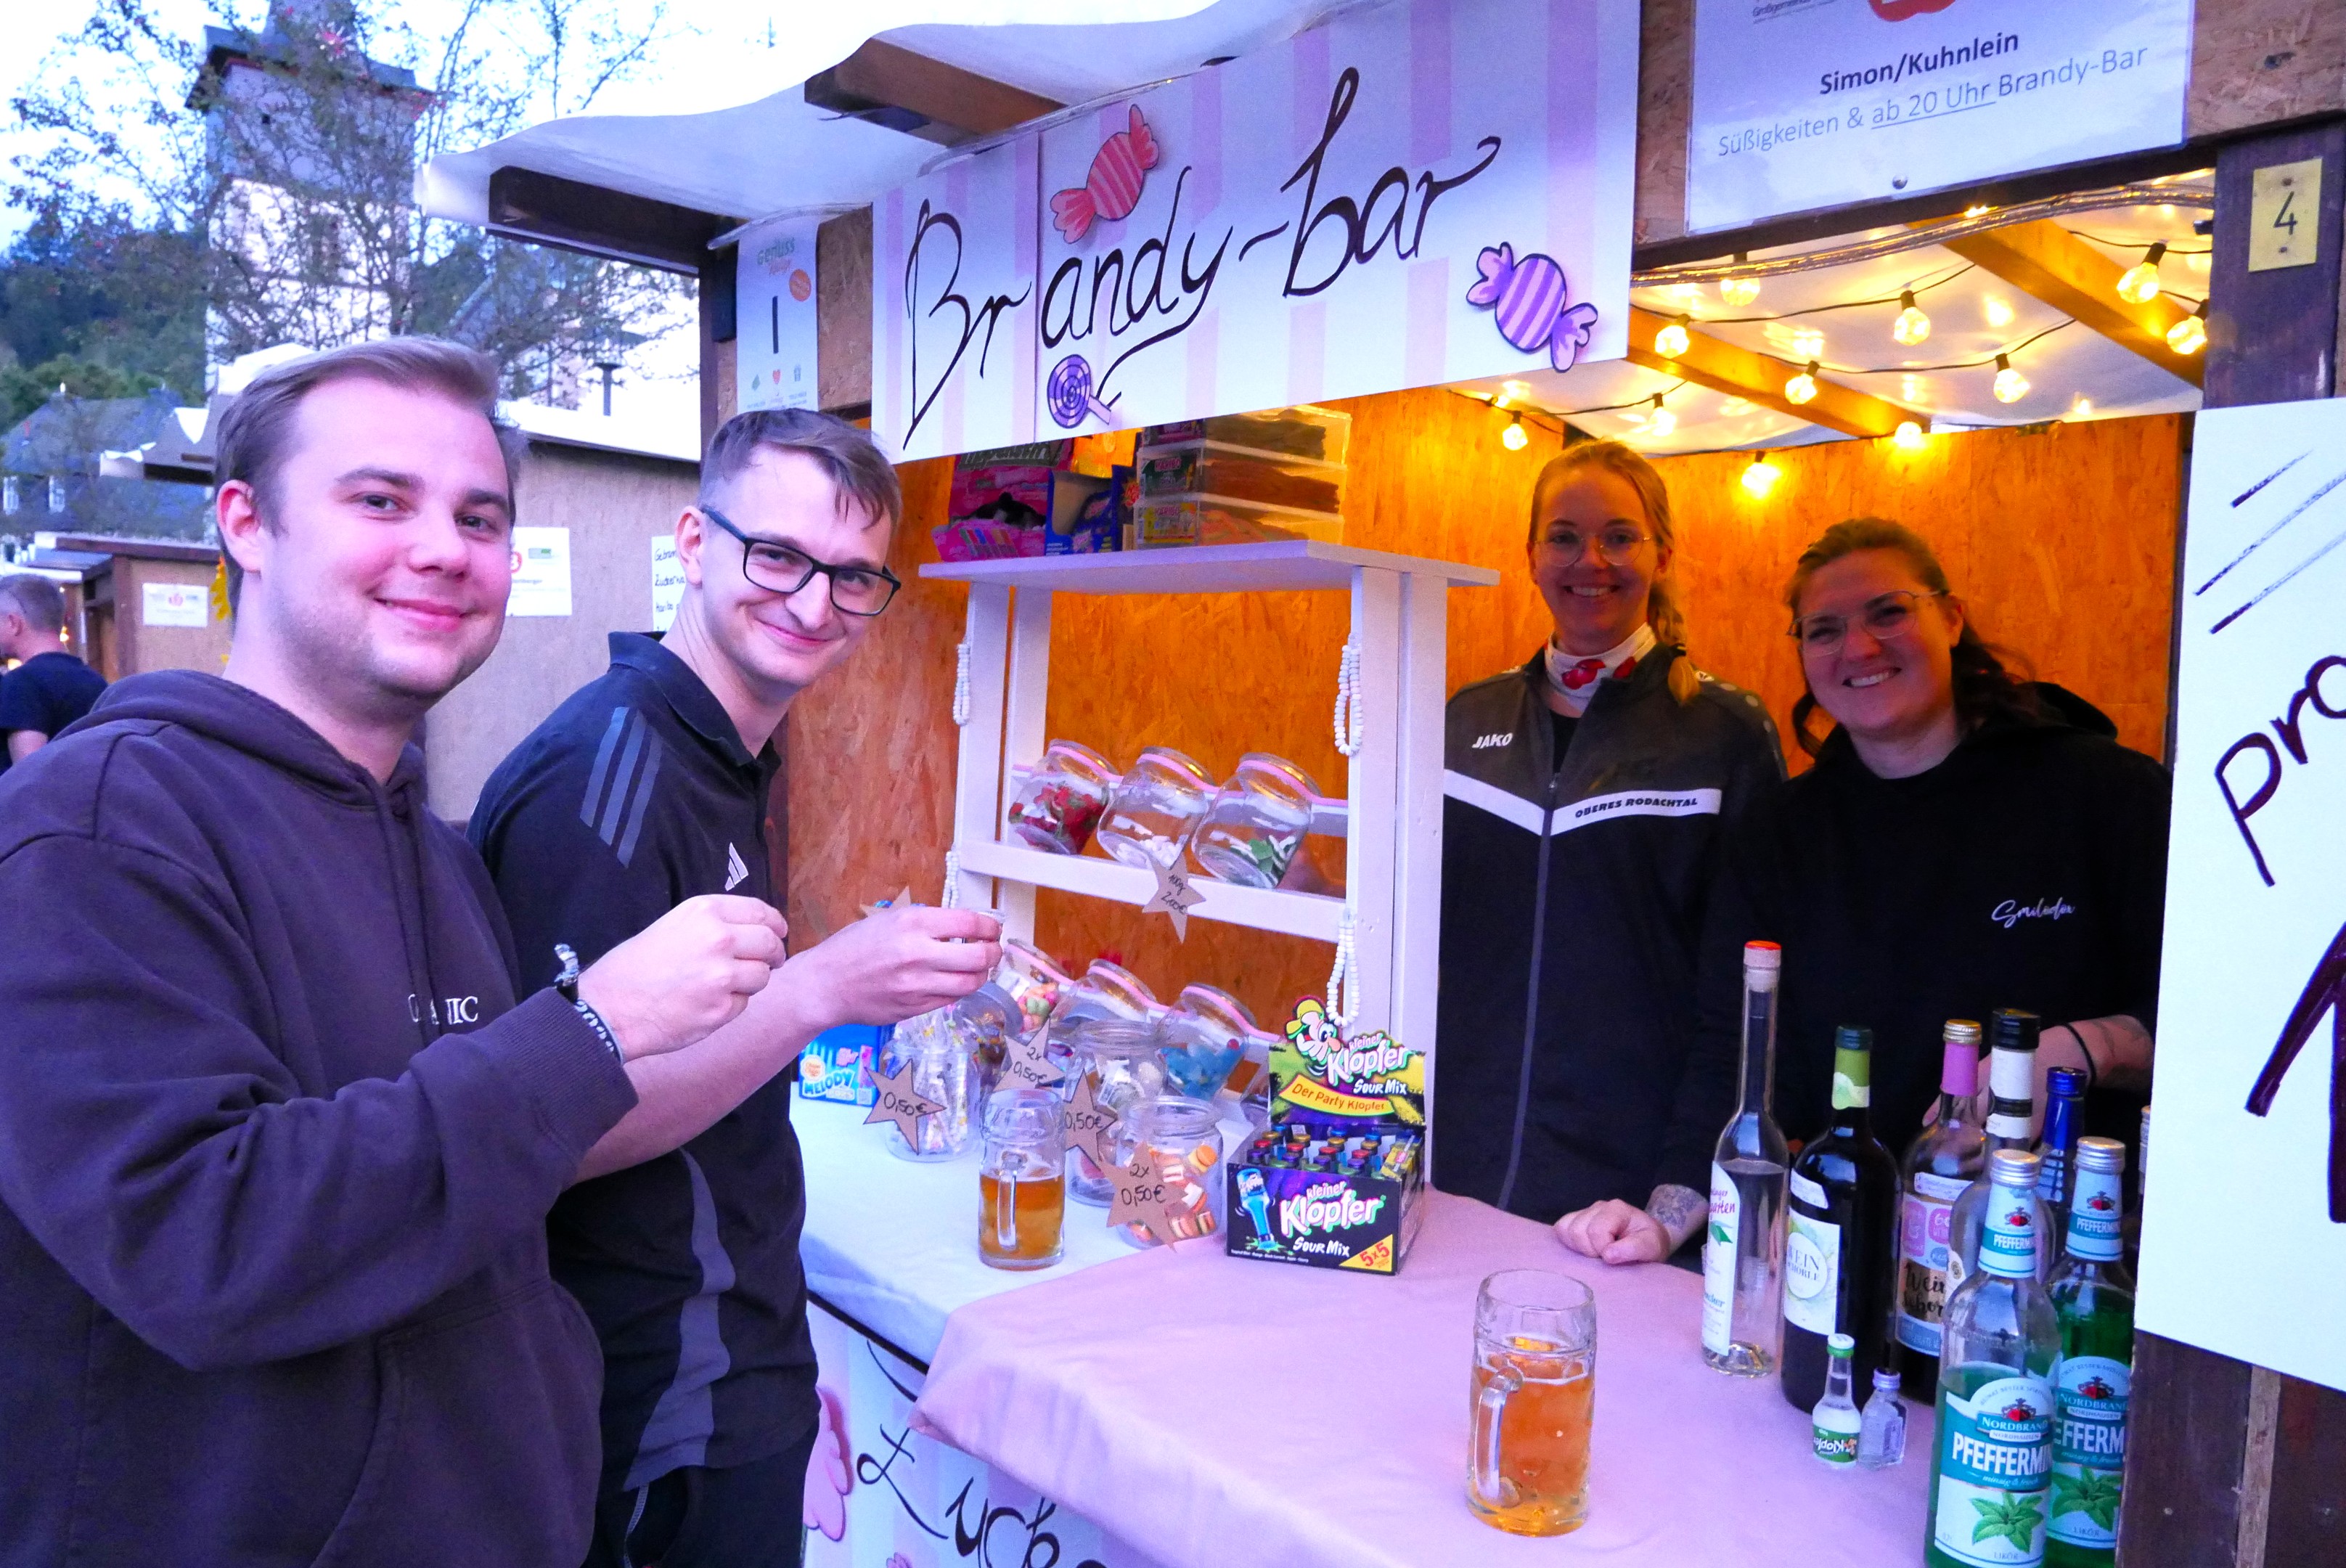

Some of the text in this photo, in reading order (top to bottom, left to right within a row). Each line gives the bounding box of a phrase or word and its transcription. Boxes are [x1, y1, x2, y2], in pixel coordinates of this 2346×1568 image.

[1820, 32, 2019, 94] Simon/Kuhnlein
[1719, 47, 2148, 156] Süßigkeiten & ab 20 Uhr Brandy-Bar
[2273, 209, 2297, 235] 4
[1471, 732, 1513, 749] JAKO
[1575, 797, 1699, 819] OBERES RODACHTAL
[1348, 1032, 1384, 1050] kleiner
[1327, 1040, 1410, 1085] Klopfer
[804, 1069, 854, 1096] MELODY
[884, 1092, 927, 1116] 0,50€
[1291, 1083, 1314, 1099] Der
[1315, 1092, 1345, 1110] Party
[1065, 1111, 1103, 1132] 0,50€
[1129, 1163, 1150, 1178] 2x
[1121, 1184, 1166, 1207] 0,50€
[1306, 1180, 1346, 1201] kleiner
[1279, 1190, 1381, 1236] Klopfer
[1982, 1416, 2048, 1432] NORDBRAND
